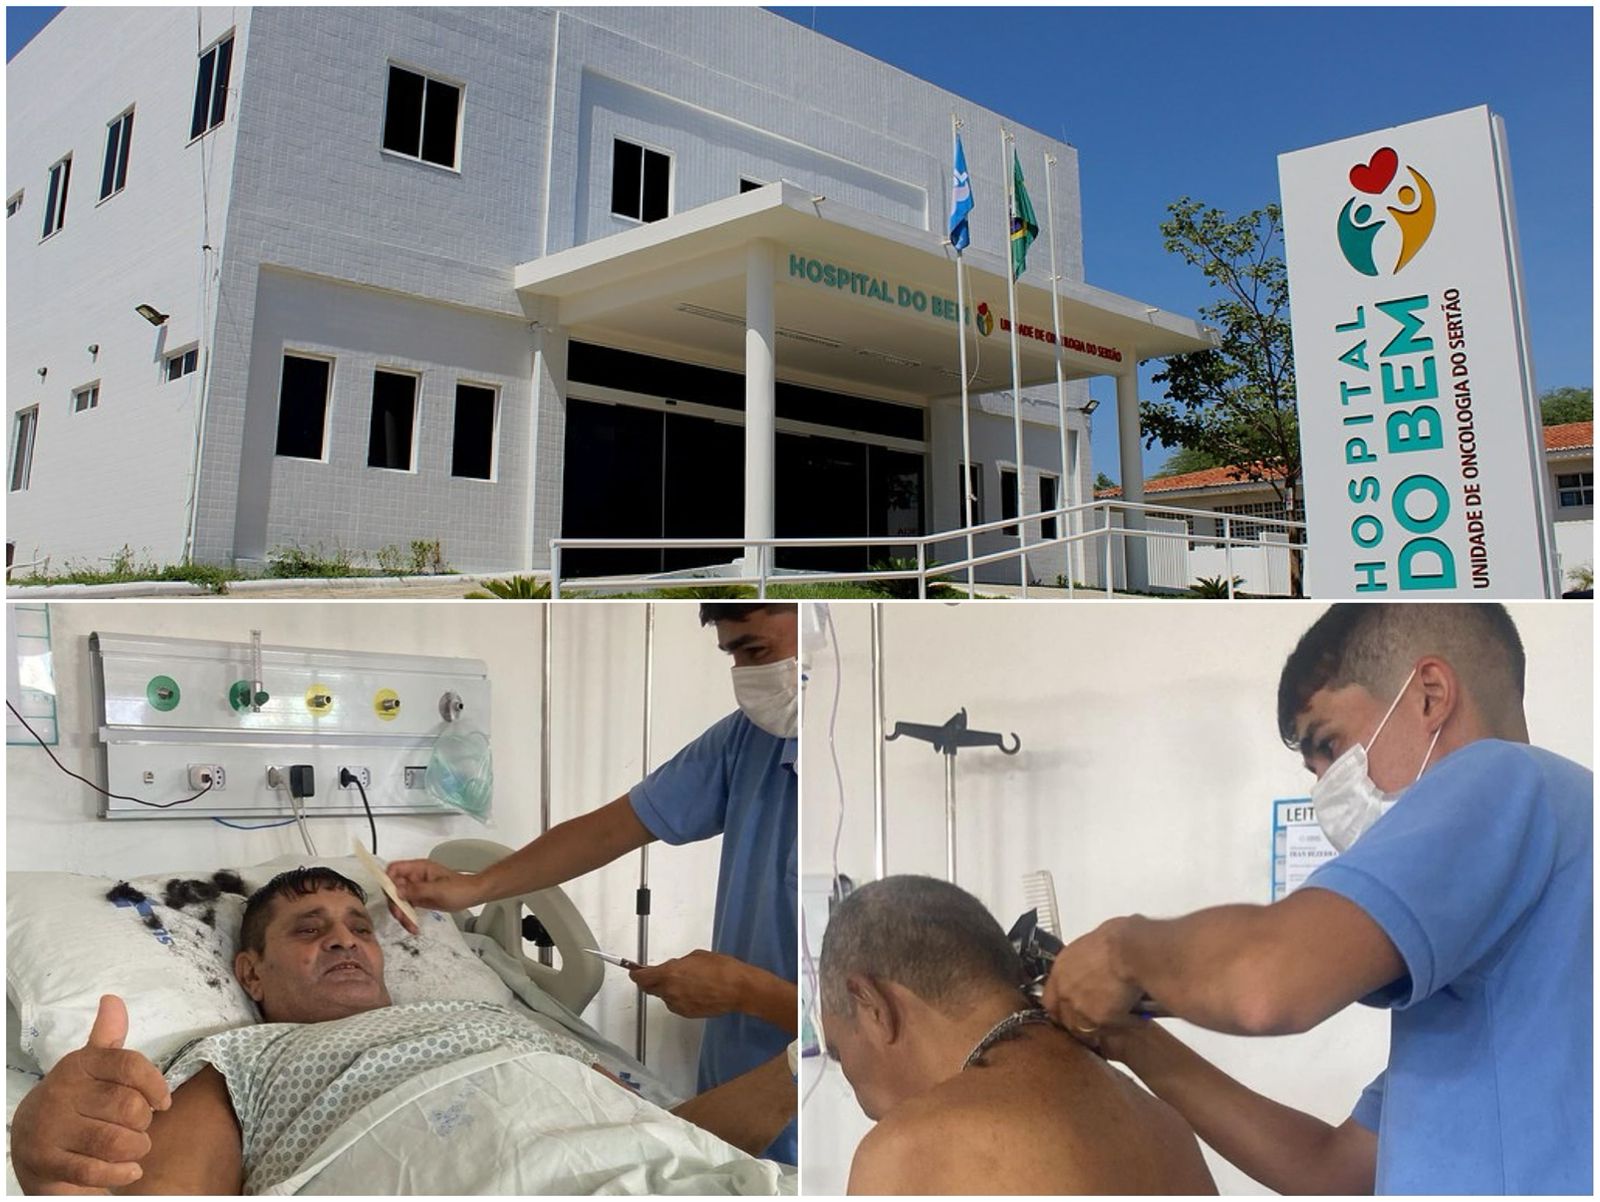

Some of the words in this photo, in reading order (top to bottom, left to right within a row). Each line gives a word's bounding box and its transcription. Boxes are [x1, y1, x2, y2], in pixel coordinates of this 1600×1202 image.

[788, 253, 894, 304] HOSPITAL
[898, 285, 928, 312] DO
[1441, 288, 1466, 350] SERTÃO
[1374, 294, 1444, 454] BEM
[1450, 352, 1469, 378] DO
[1335, 305, 1388, 593] HOSPITAL
[1453, 379, 1479, 479] ONCOLOGIA
[1464, 483, 1482, 507] DE
[1391, 474, 1458, 591] DO
[1466, 510, 1490, 589] UNIDADE
[1286, 807, 1315, 822] LEIT
